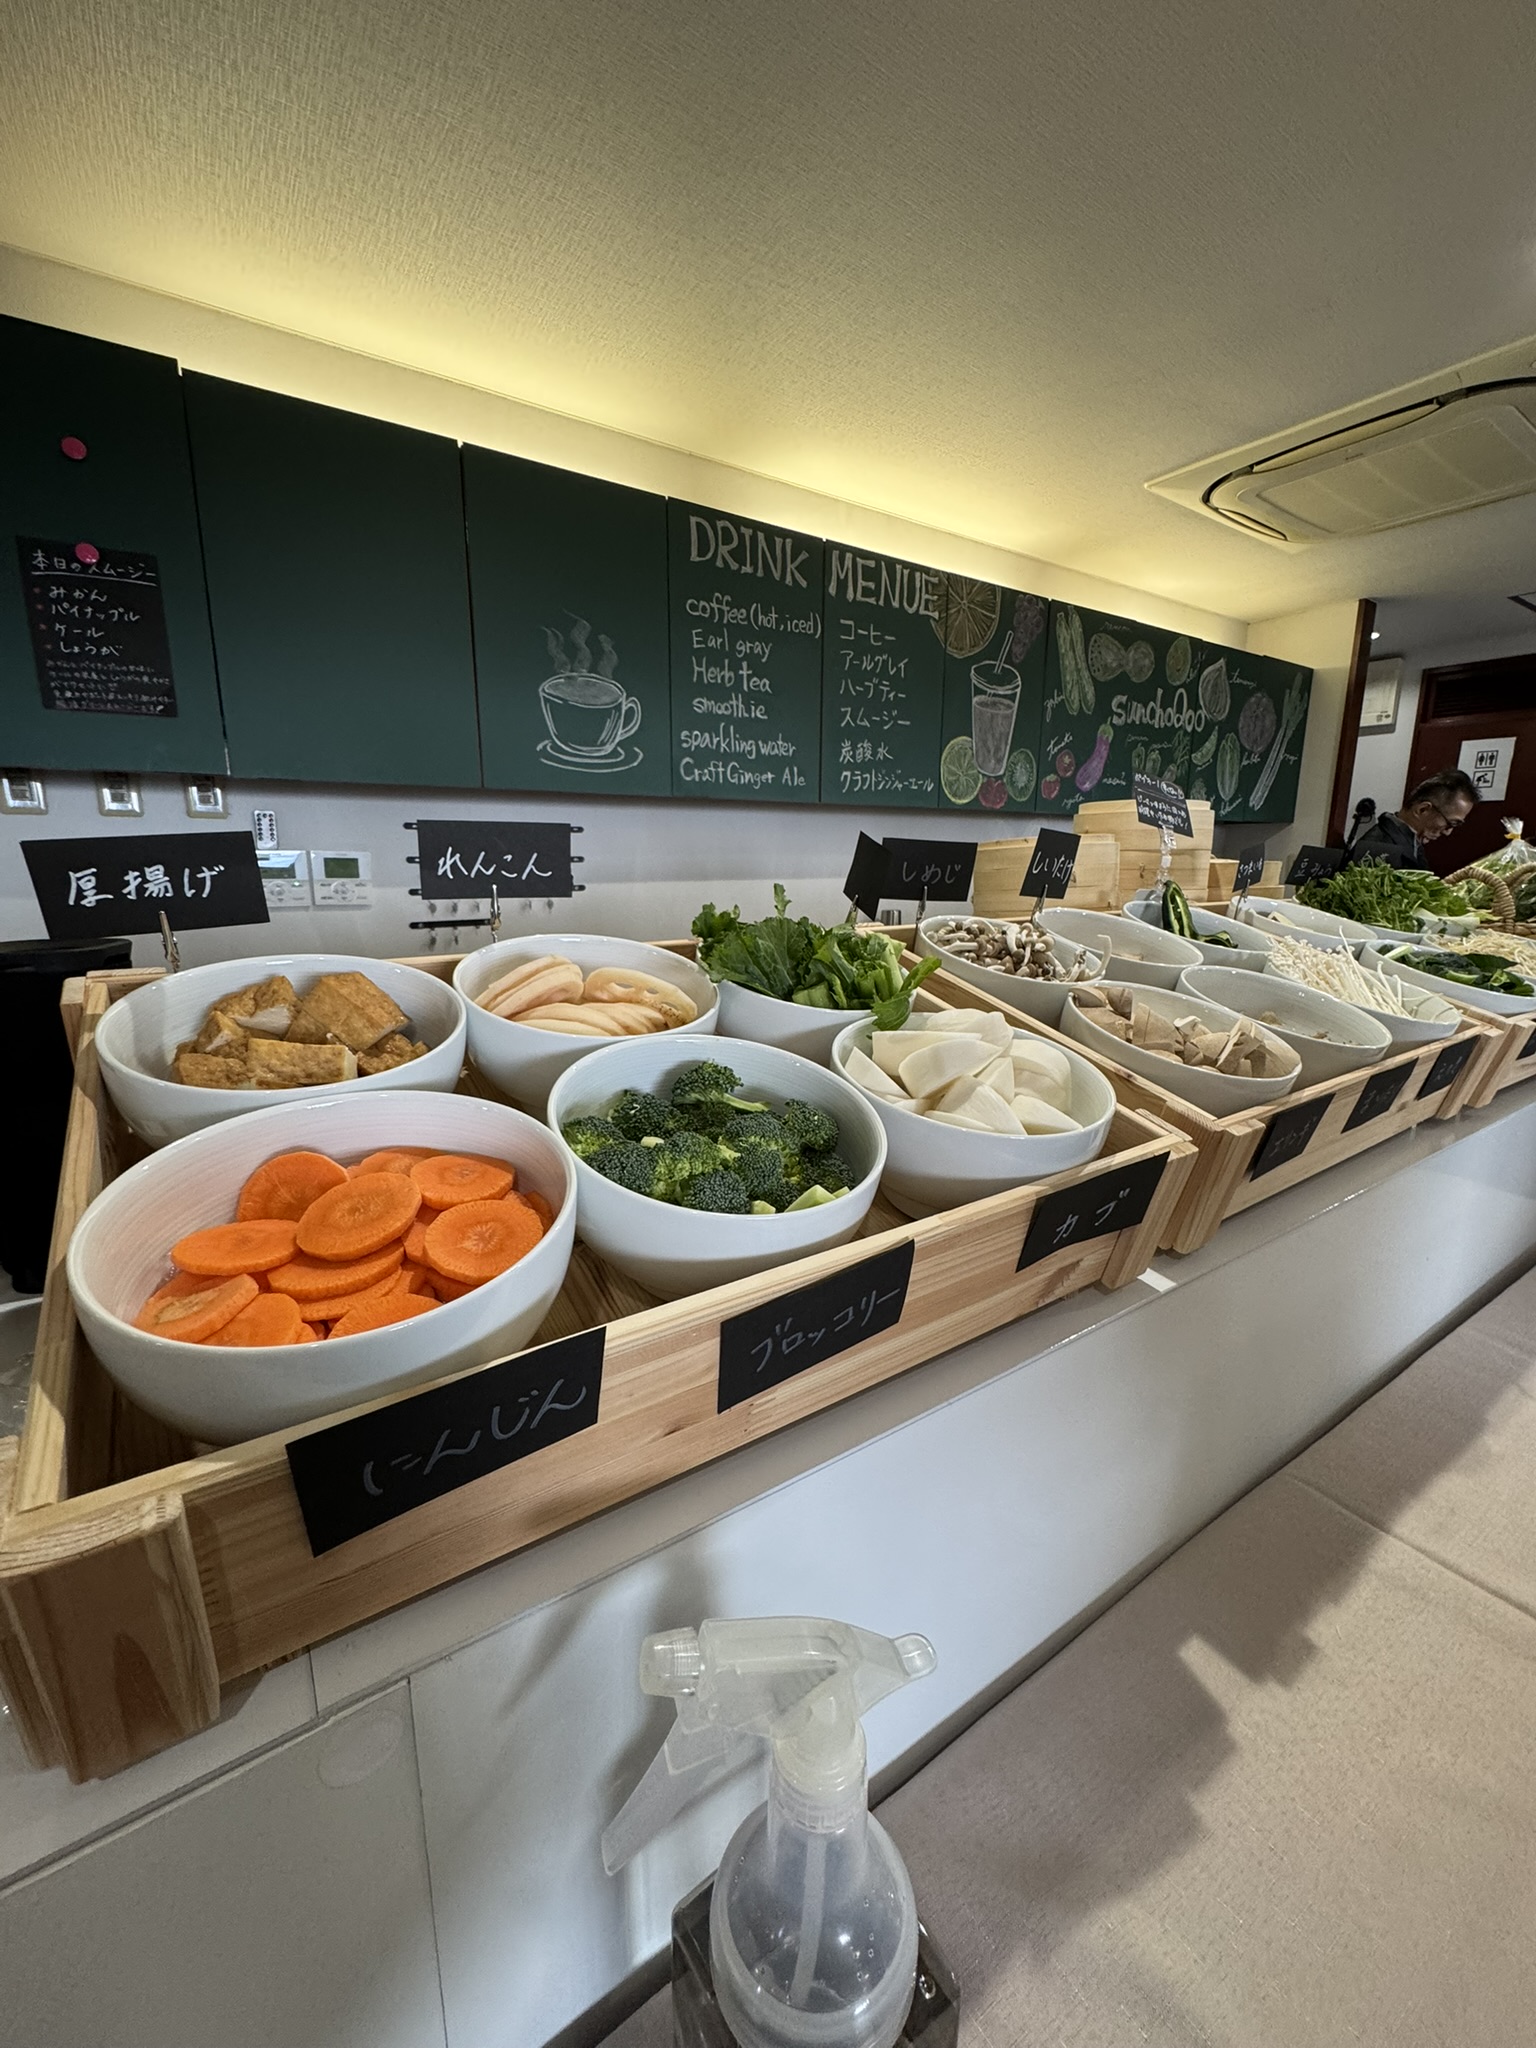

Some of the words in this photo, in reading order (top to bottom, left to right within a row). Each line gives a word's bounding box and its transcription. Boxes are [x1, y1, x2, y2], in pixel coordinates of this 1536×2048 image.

[689, 515, 809, 588] DRINK
[828, 550, 939, 619] MENUE
[49, 585, 107, 602] みかん
[51, 602, 141, 621] パイナップル
[55, 622, 104, 637] ケール
[840, 618, 896, 646] コーヒー
[60, 641, 123, 656] しょうが
[692, 628, 728, 650] Earl
[736, 638, 772, 662] gray
[692, 656, 735, 688] Herb
[739, 661, 772, 694] tea
[840, 650, 909, 678] アールグレイ
[840, 678, 907, 702] ハーブティー
[692, 693, 768, 720] smoothie
[840, 706, 911, 730] スムージー
[680, 722, 756, 759] sparkling
[758, 733, 797, 758] water
[840, 739, 894, 765] 炭酸水
[782, 767, 806, 787] Ale
[437, 846, 552, 880] れんこん
[902, 861, 962, 884] しめじ
[1032, 851, 1074, 885] しいたけ
[68, 863, 226, 908] 厚揚げ
[1053, 1187, 1131, 1245] カブ
[751, 1288, 901, 1373] ブロッコリー
[363, 1378, 588, 1497] にんじん
